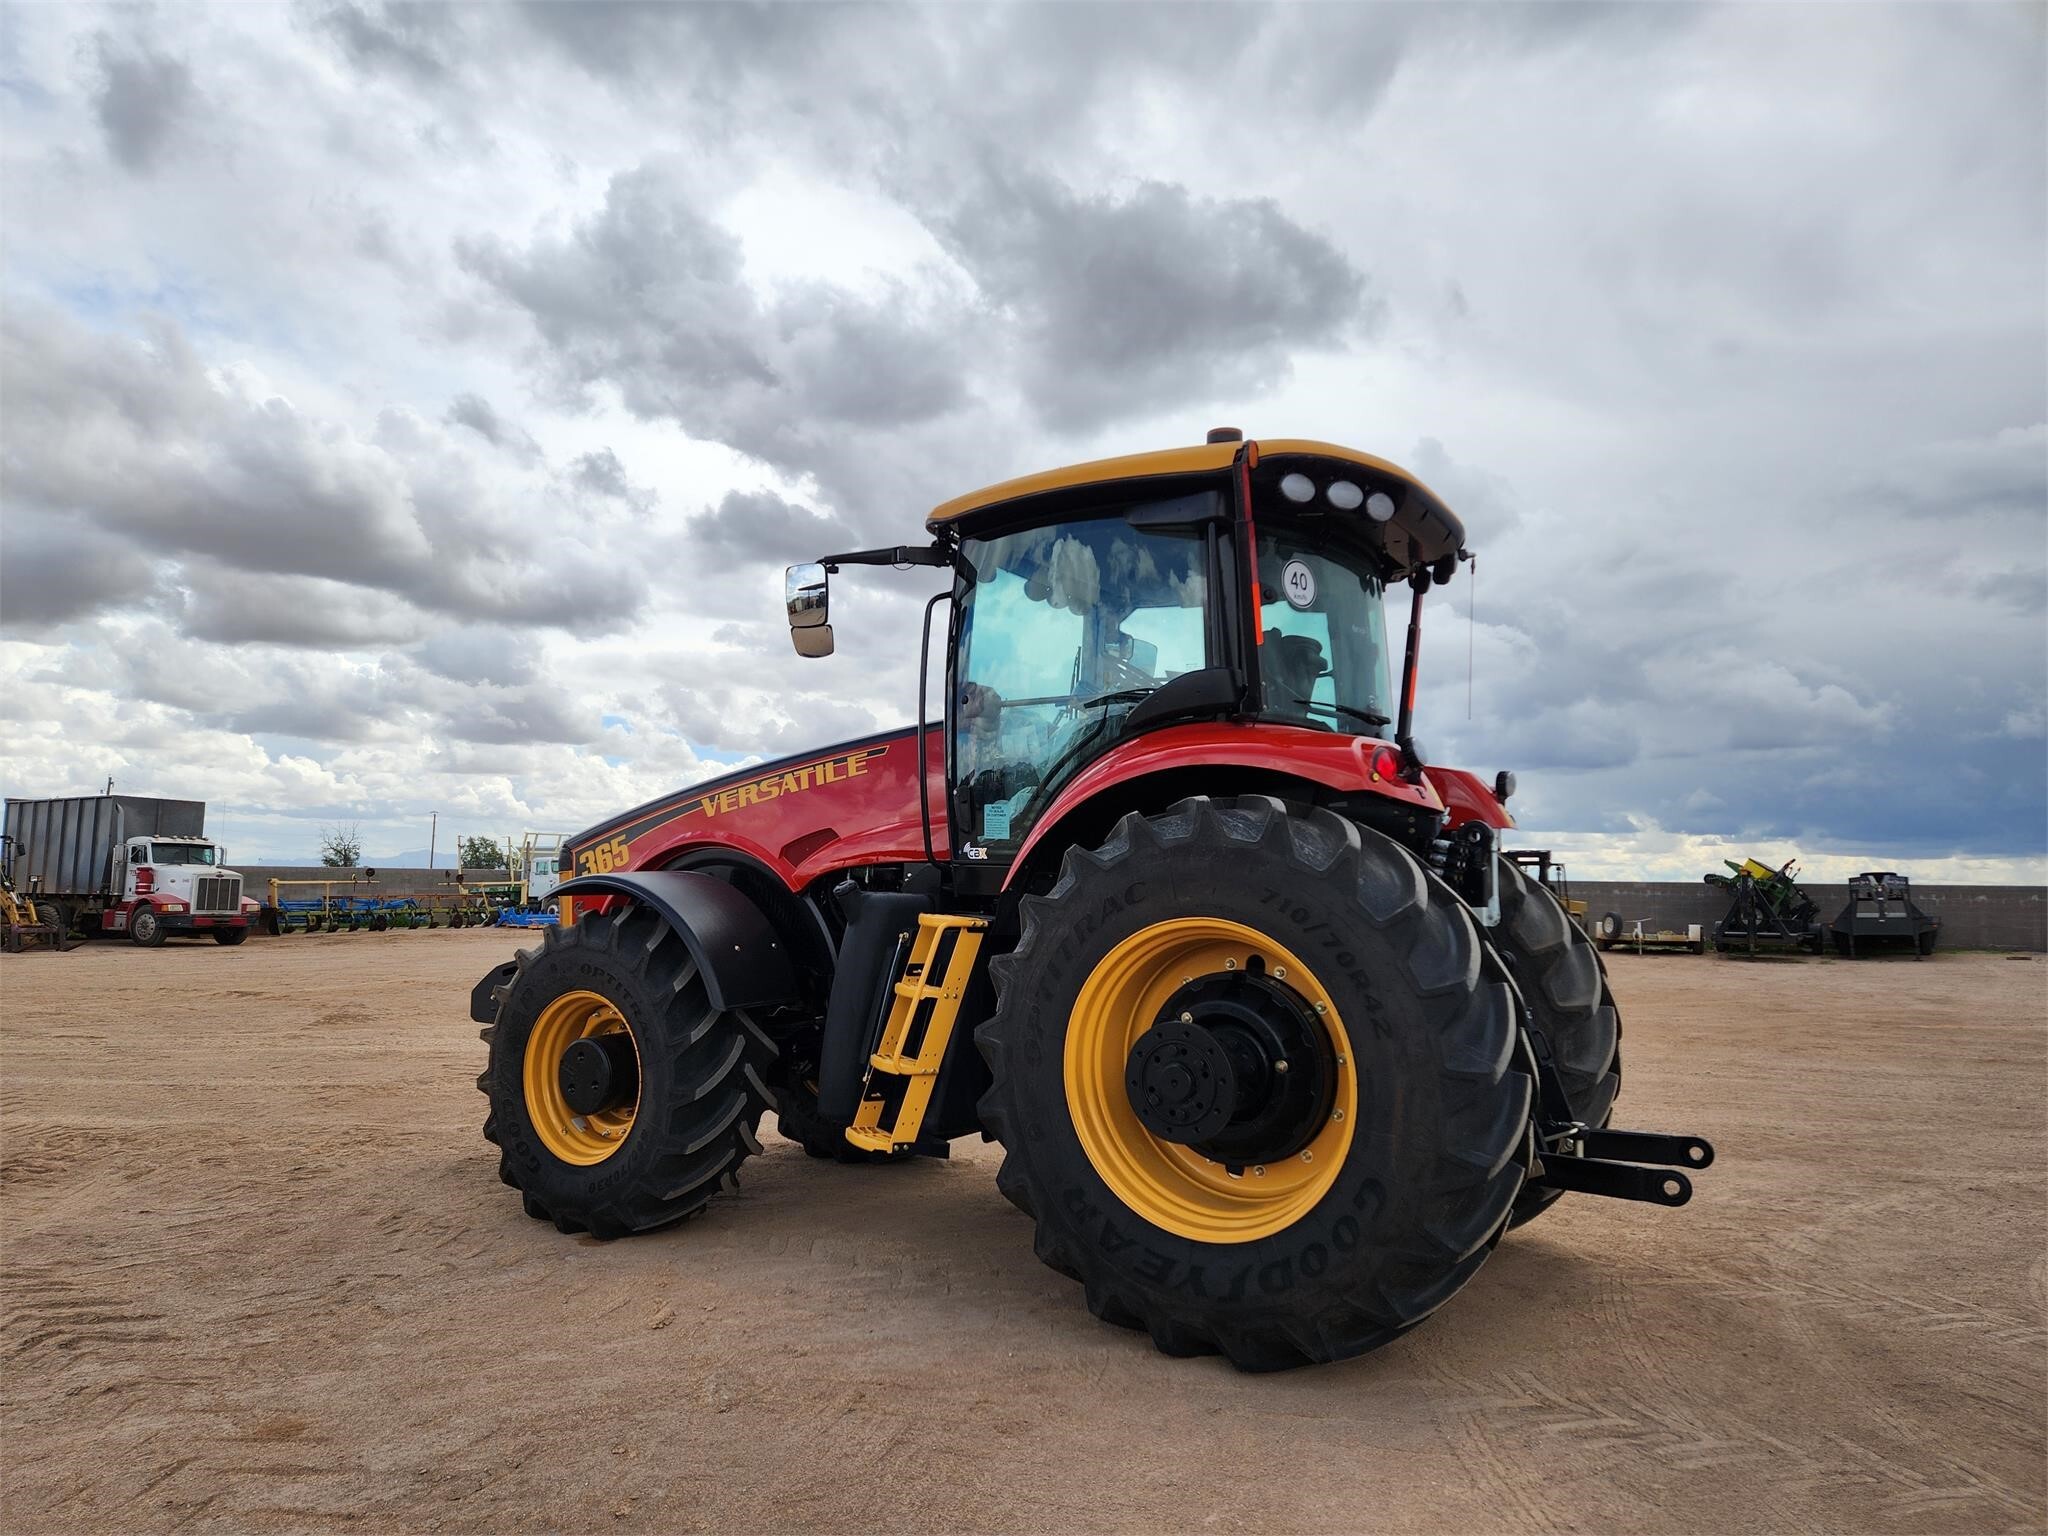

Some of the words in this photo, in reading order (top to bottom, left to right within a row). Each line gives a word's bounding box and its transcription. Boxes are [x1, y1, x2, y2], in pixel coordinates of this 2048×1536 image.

[1290, 571, 1308, 591] 40
[701, 752, 869, 818] VERSATILE
[579, 834, 630, 876] 365
[1062, 1177, 1389, 1300] GOODYEAR
